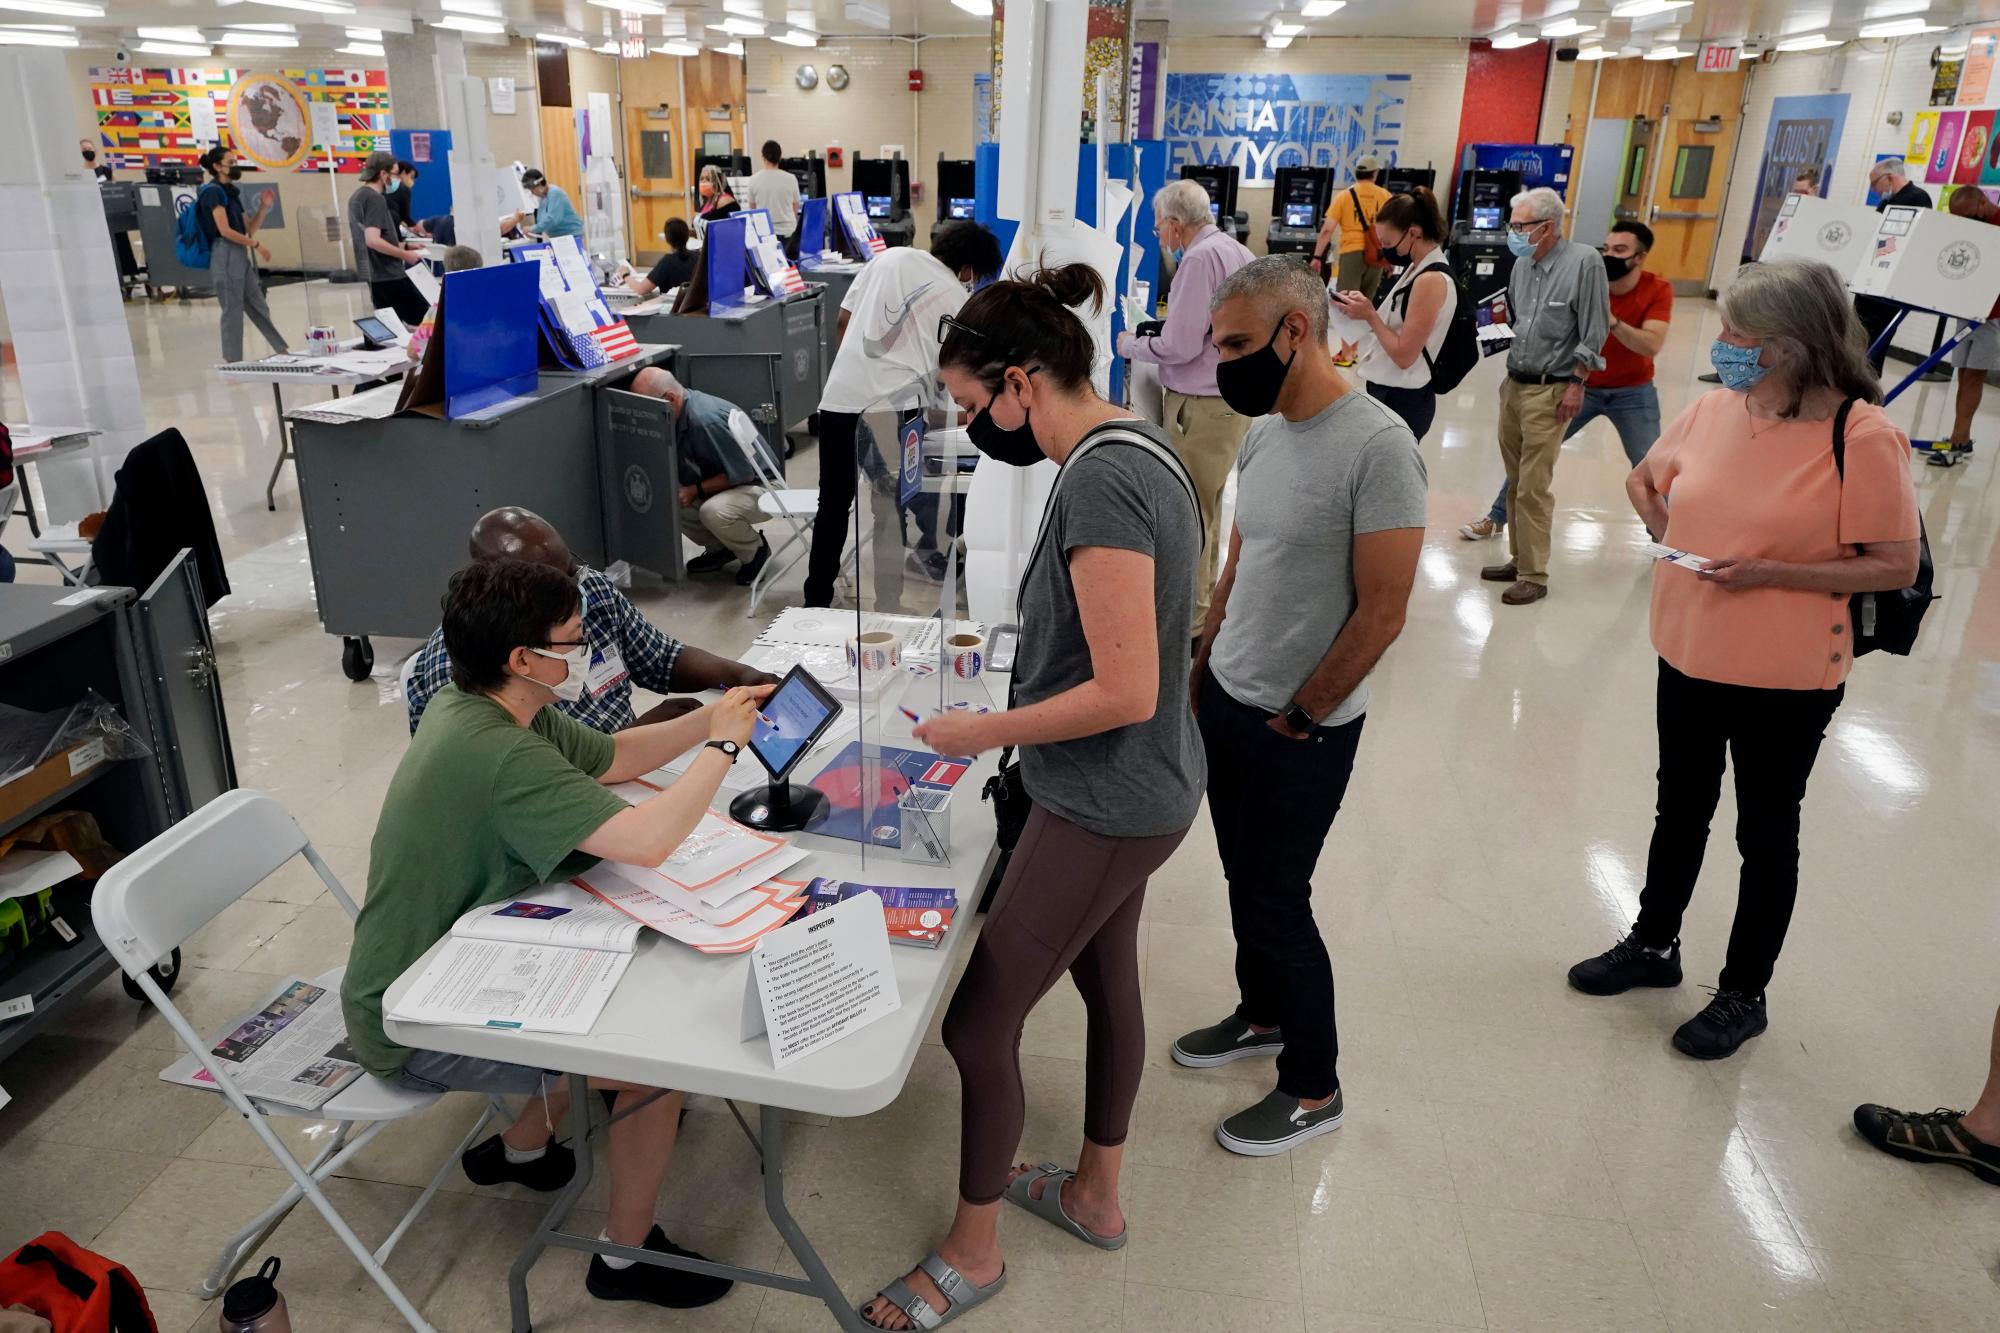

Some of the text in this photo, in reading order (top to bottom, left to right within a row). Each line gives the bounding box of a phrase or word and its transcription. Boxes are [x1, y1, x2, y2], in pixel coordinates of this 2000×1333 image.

[1704, 45, 1734, 68] EXIT
[1772, 125, 1813, 164] LOUIS
[1248, 140, 1362, 181] YORK
[807, 917, 835, 934] INSPECTOR
[776, 955, 789, 963] cannot
[779, 970, 789, 978] Voter
[811, 957, 822, 965] within
[795, 971, 812, 983] signature
[817, 963, 830, 973] missing
[783, 989, 796, 998] wrong
[796, 981, 813, 993] signature
[817, 974, 827, 982] listed
[799, 993, 808, 1002] party
[809, 984, 828, 996] enrollment
[832, 977, 842, 985] listed
[842, 969, 859, 981] incorrectly
[779, 1018, 787, 1026] but
[787, 1015, 797, 1023] voter
[812, 1004, 820, 1012] have
[783, 1031, 797, 1042] records
[809, 1020, 820, 1029] Board
[820, 1013, 835, 1024] indicate
[842, 1005, 850, 1013] they
[858, 995, 870, 1004] already
[787, 1008, 796, 1017] book
[811, 996, 822, 1005] words
[789, 1023, 800, 1032] Voter
[800, 1018, 812, 1027] claims
[817, 1011, 826, 1019] have
[834, 1002, 844, 1010] voted
[788, 1039, 799, 1050] MUST
[799, 1036, 808, 1044] offer
[816, 1028, 825, 1036] voter
[831, 1016, 848, 1028] AFFIDAVIT
[849, 1008, 862, 1019] BALLOT
[784, 1043, 804, 1058] Certificate
[809, 1036, 820, 1046] obtain
[824, 1029, 834, 1038] Court
